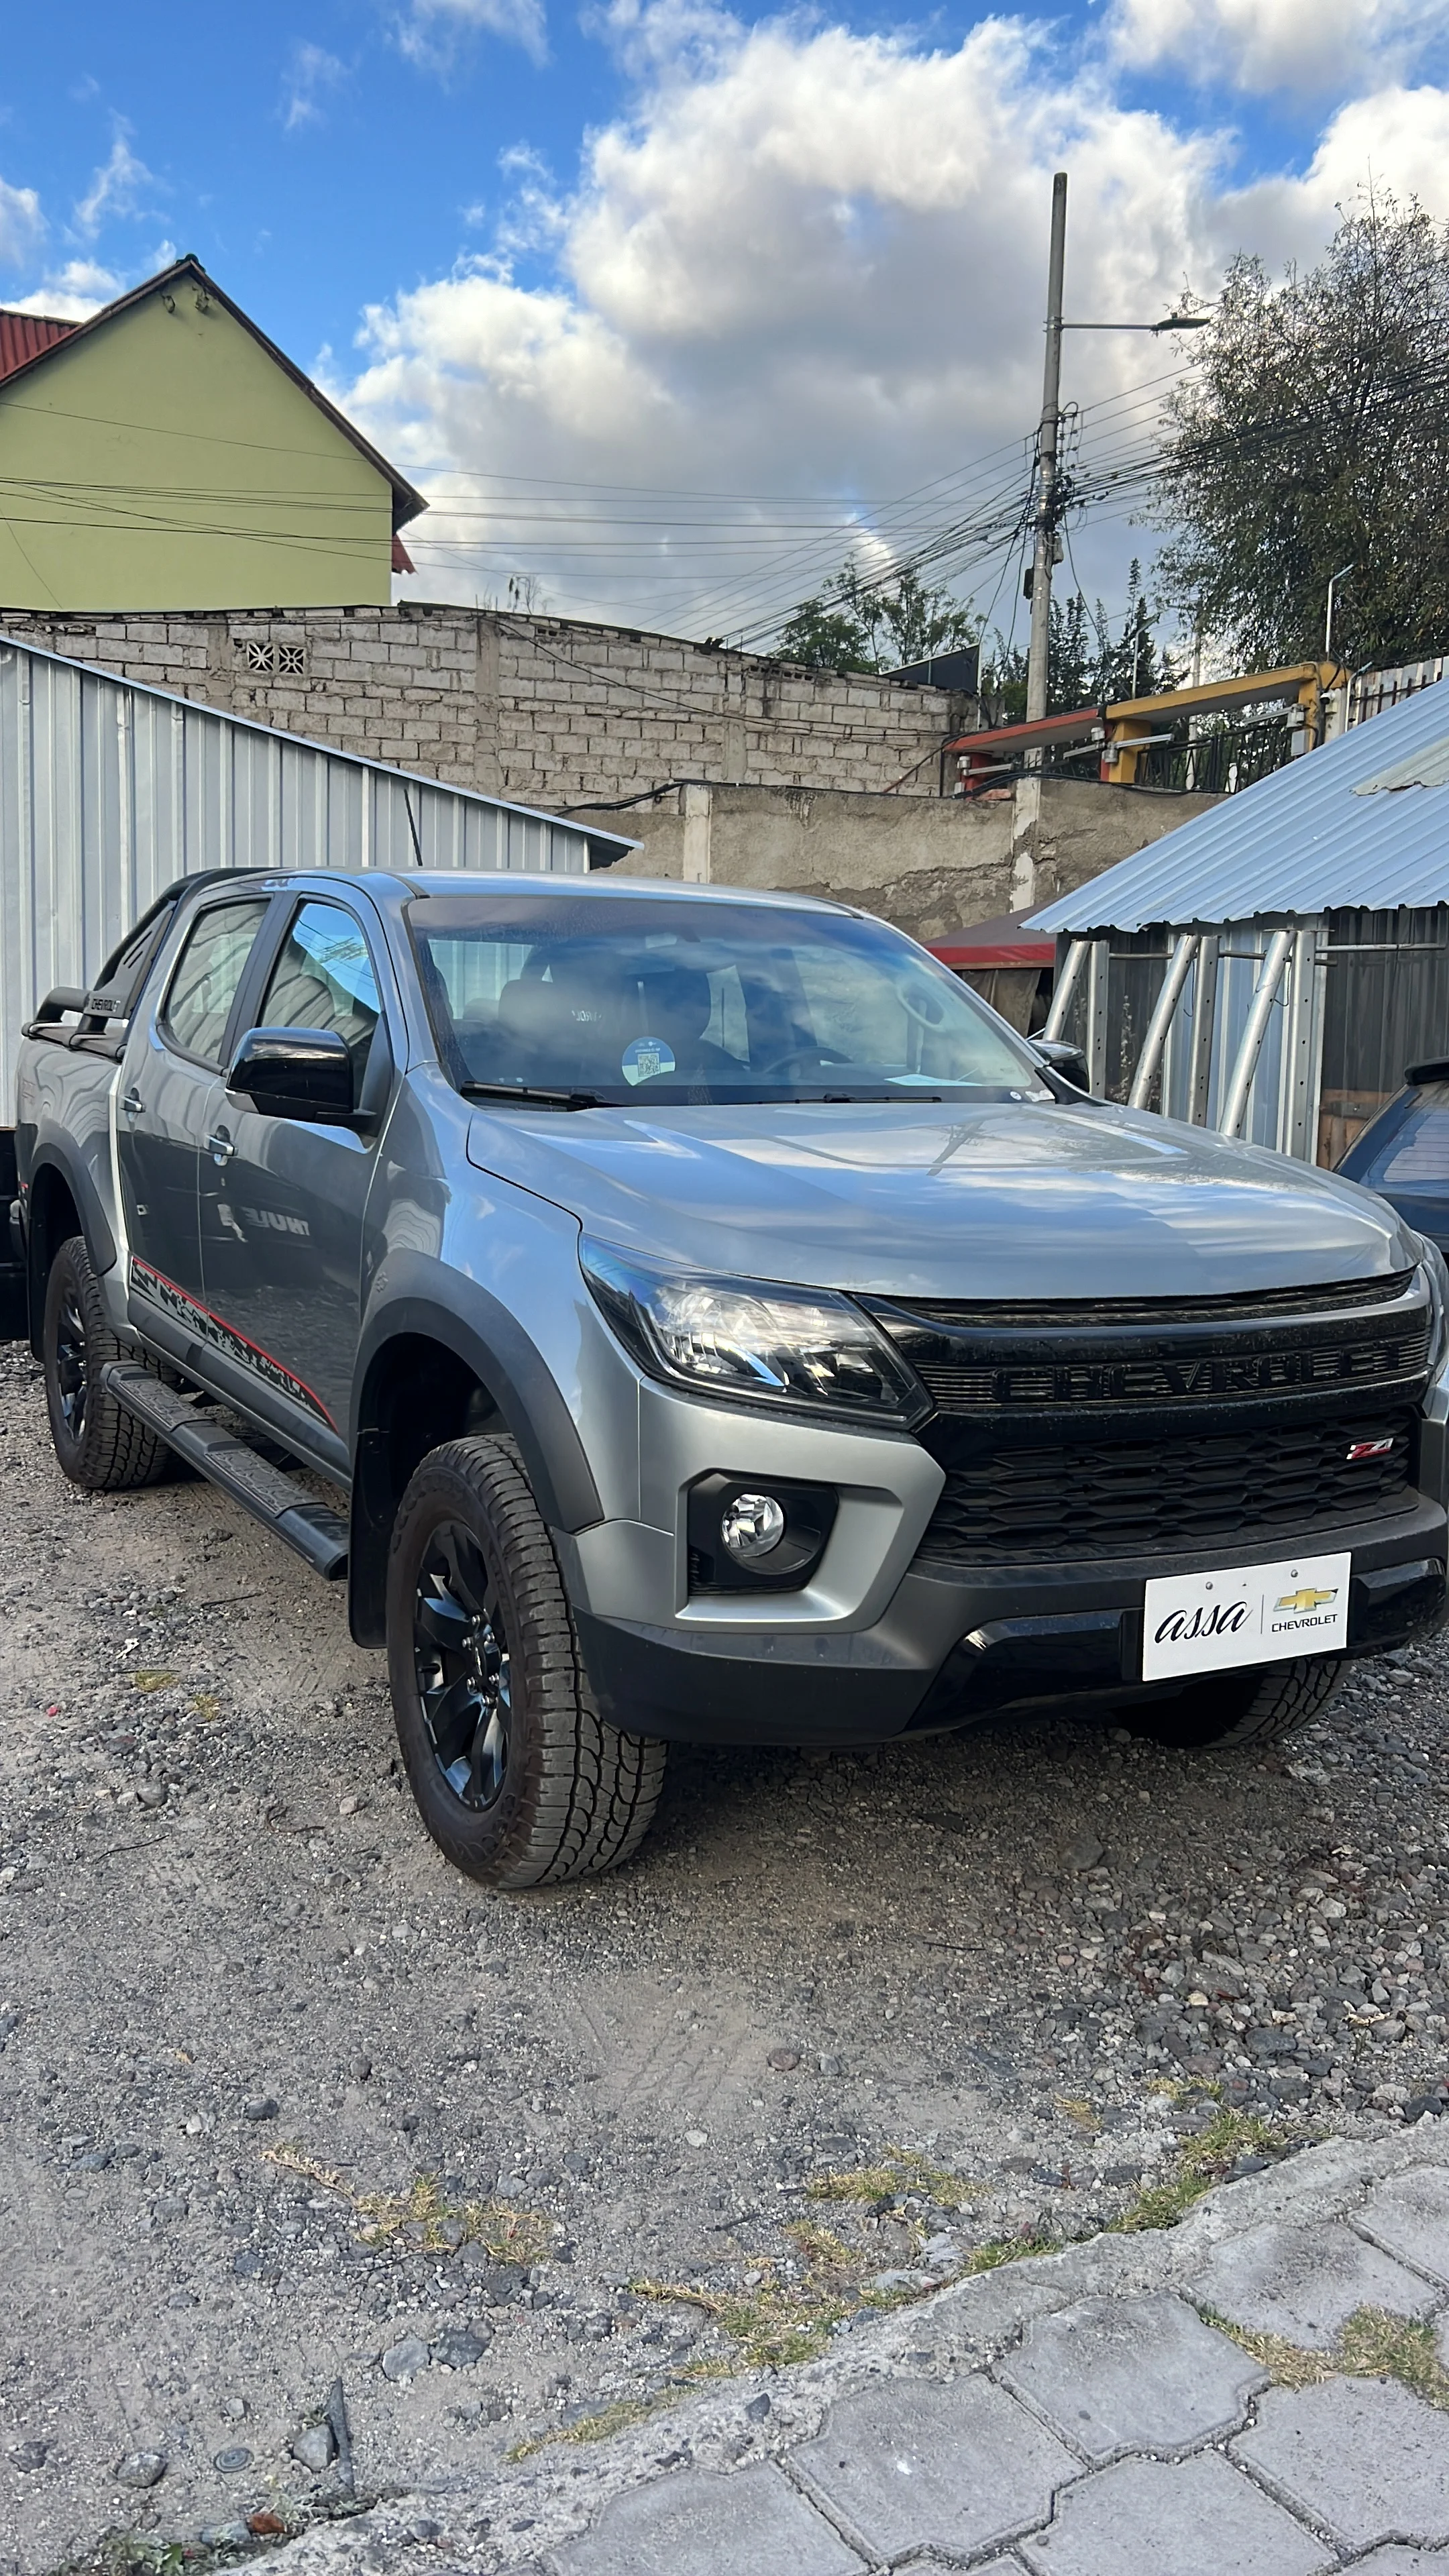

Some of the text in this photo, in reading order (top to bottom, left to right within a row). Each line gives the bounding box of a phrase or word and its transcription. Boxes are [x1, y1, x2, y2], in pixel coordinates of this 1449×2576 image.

[991, 1340, 1409, 1401] CHEVROLET
[1346, 1438, 1394, 1460] Z71
[1155, 1601, 1253, 1644] assa
[1272, 1614, 1338, 1632] CHEVROLET
